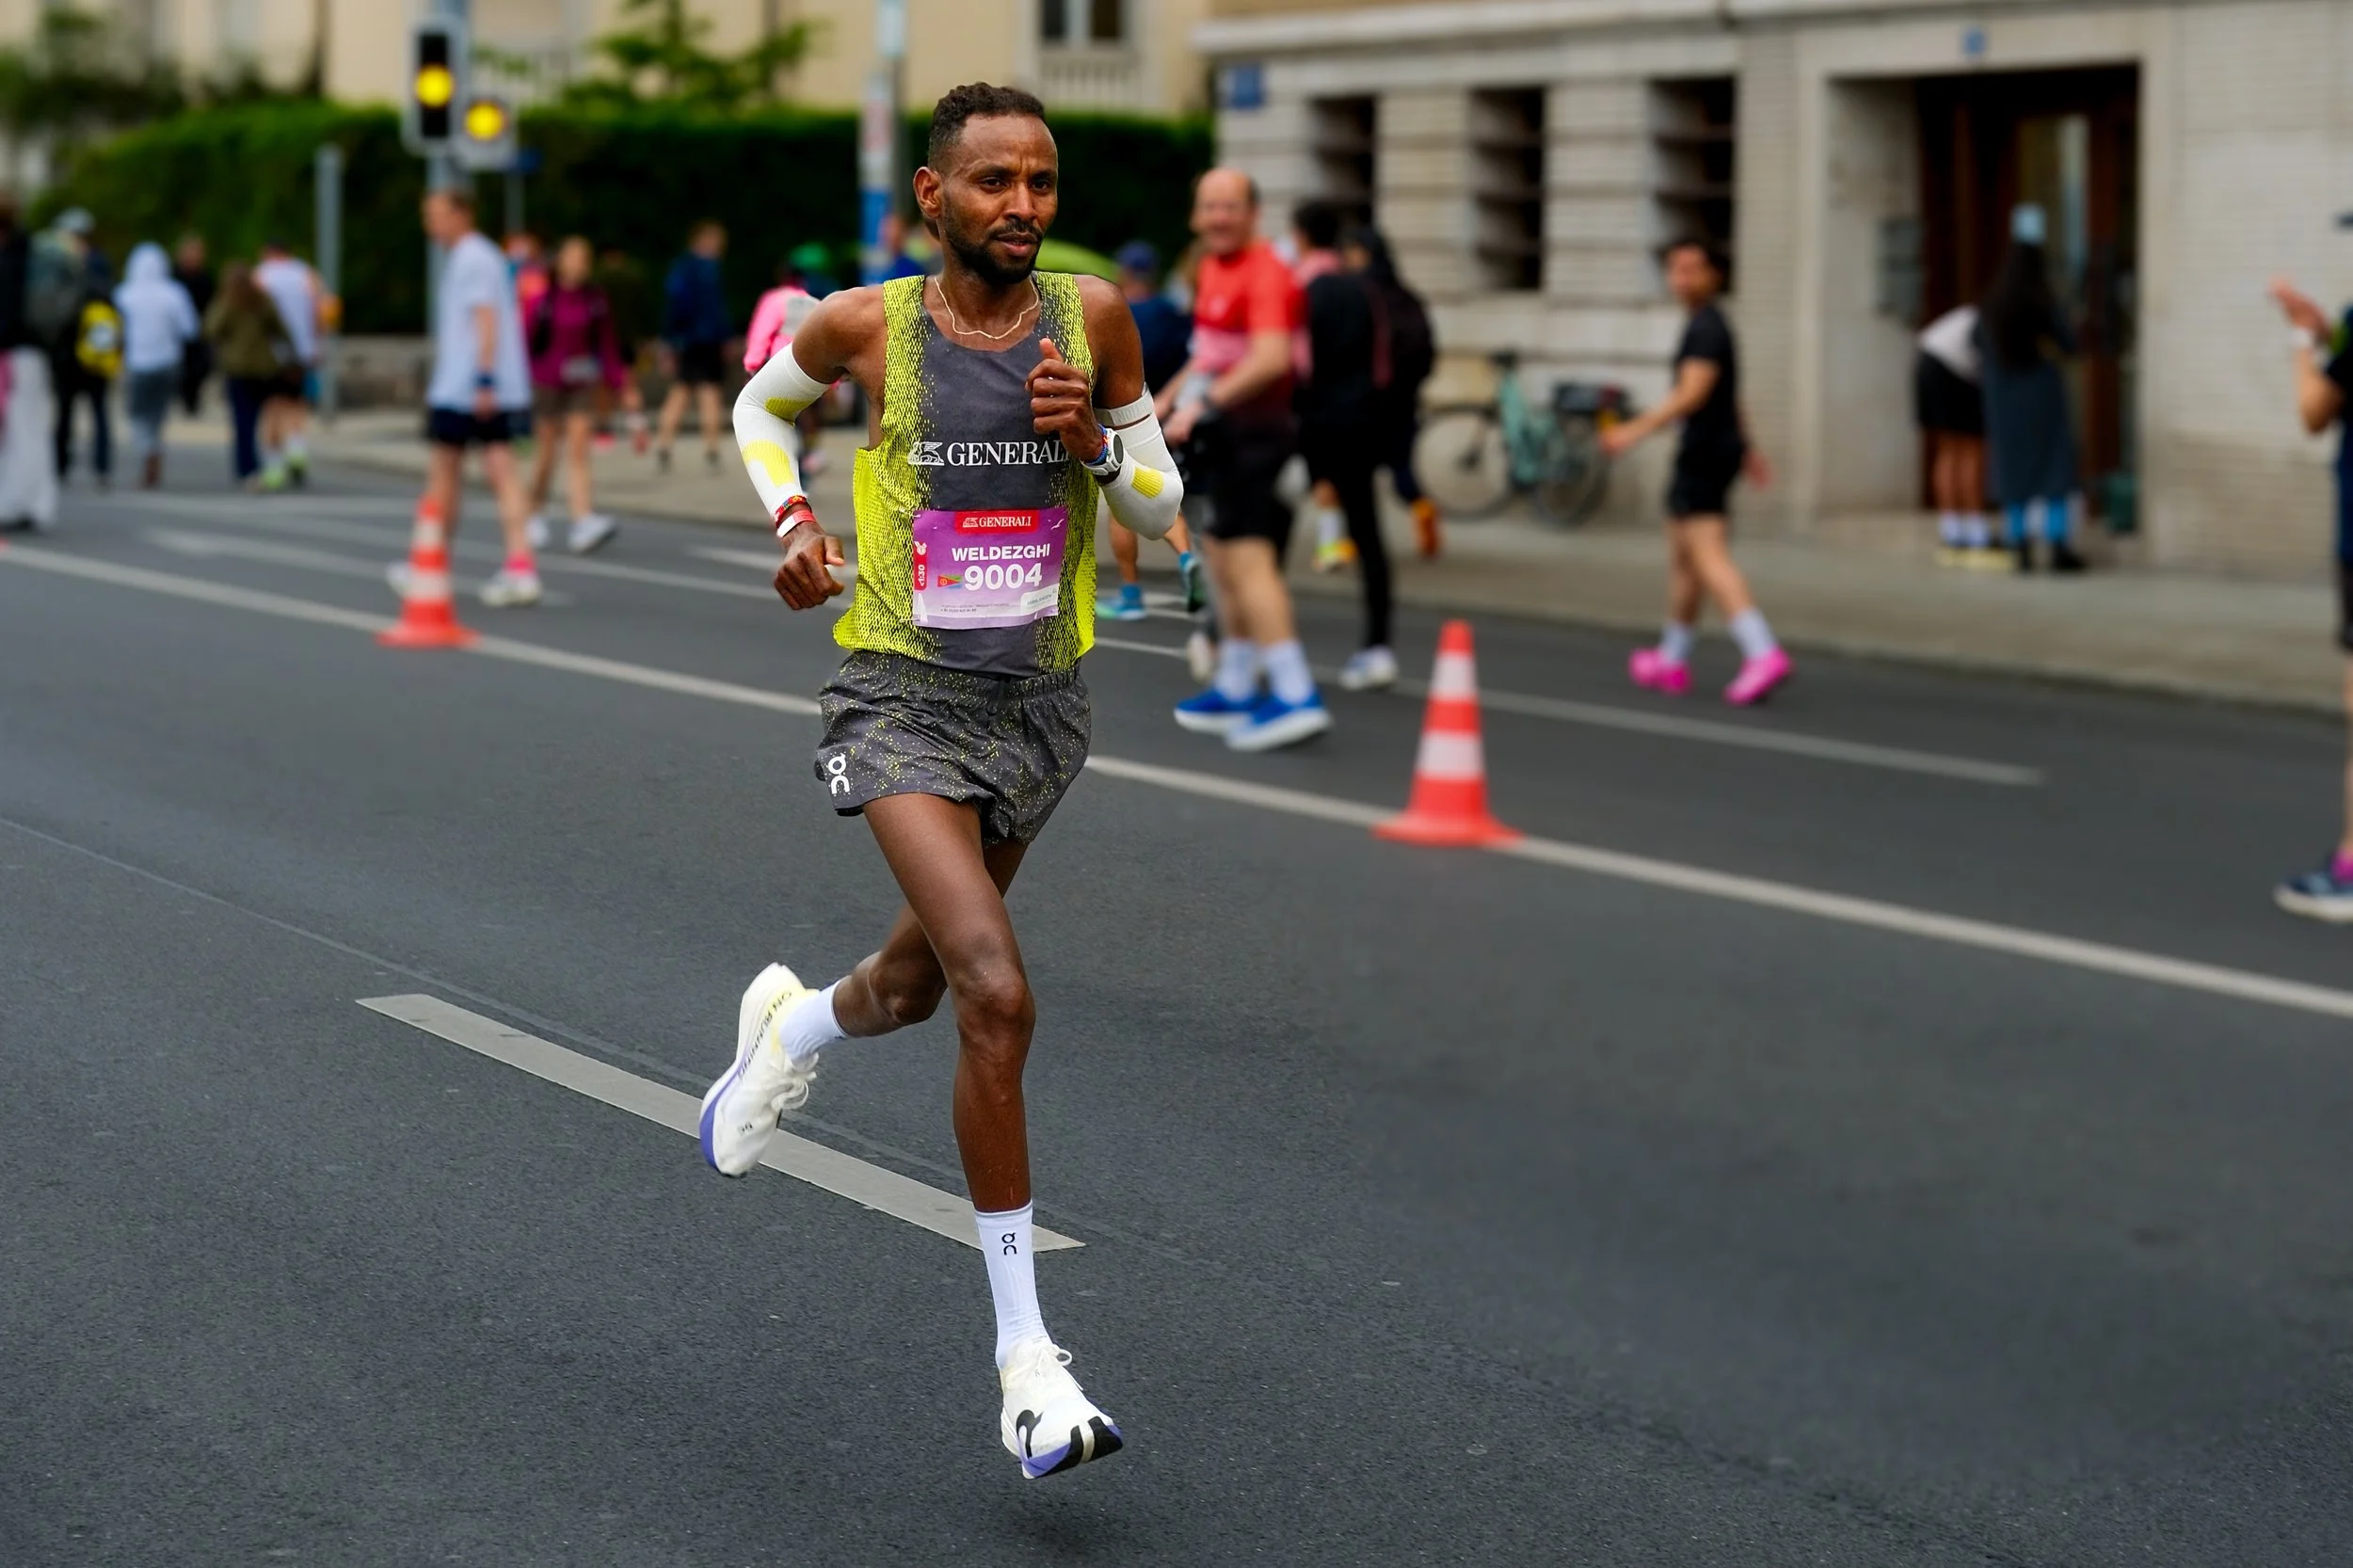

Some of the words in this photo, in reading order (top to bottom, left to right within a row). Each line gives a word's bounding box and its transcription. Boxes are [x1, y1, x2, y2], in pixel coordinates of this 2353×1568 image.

[979, 516, 1032, 528] GENERALI
[952, 543, 1050, 561] WELDEZGHI
[964, 563, 1043, 591] 9004
